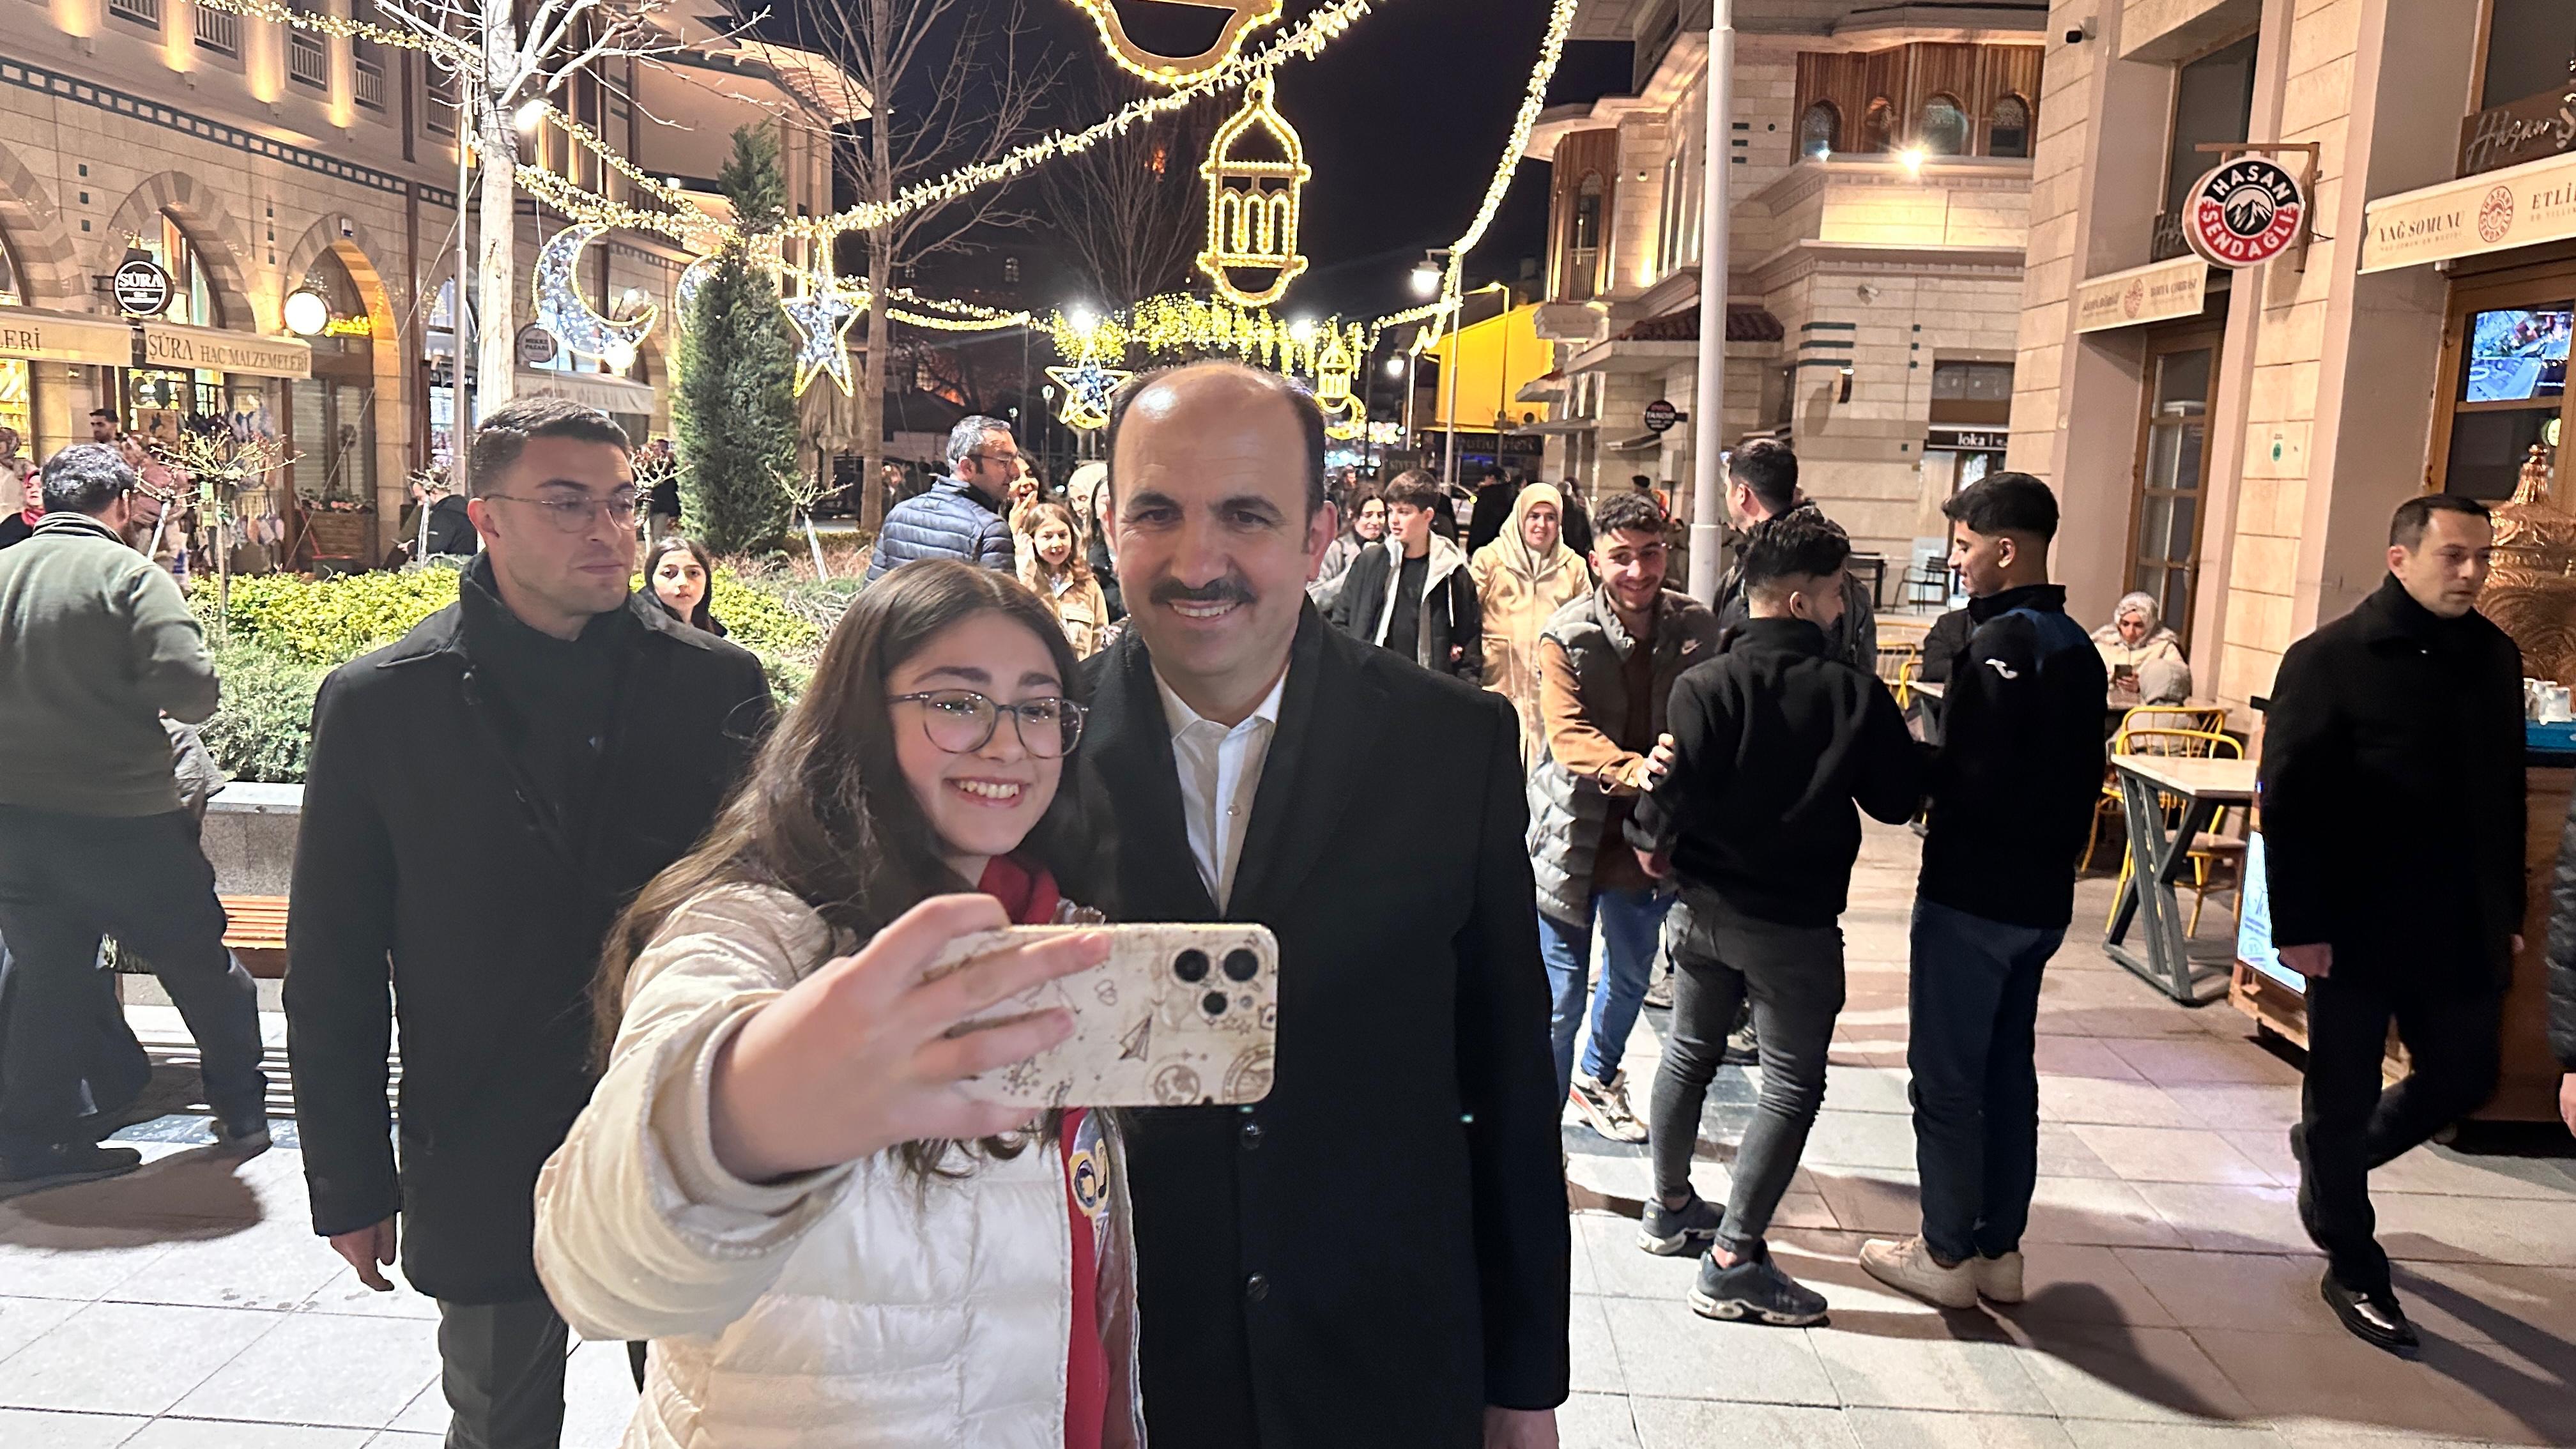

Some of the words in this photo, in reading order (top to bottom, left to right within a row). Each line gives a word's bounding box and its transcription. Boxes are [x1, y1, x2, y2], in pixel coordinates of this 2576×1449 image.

[2212, 165, 2291, 201] HASAN
[2380, 220, 2405, 242] YAĞ
[0, 327, 40, 351] ERİ
[200, 345, 226, 364] HAC
[229, 349, 309, 372] MALZEMELERİ
[1958, 433, 1985, 446] loka
